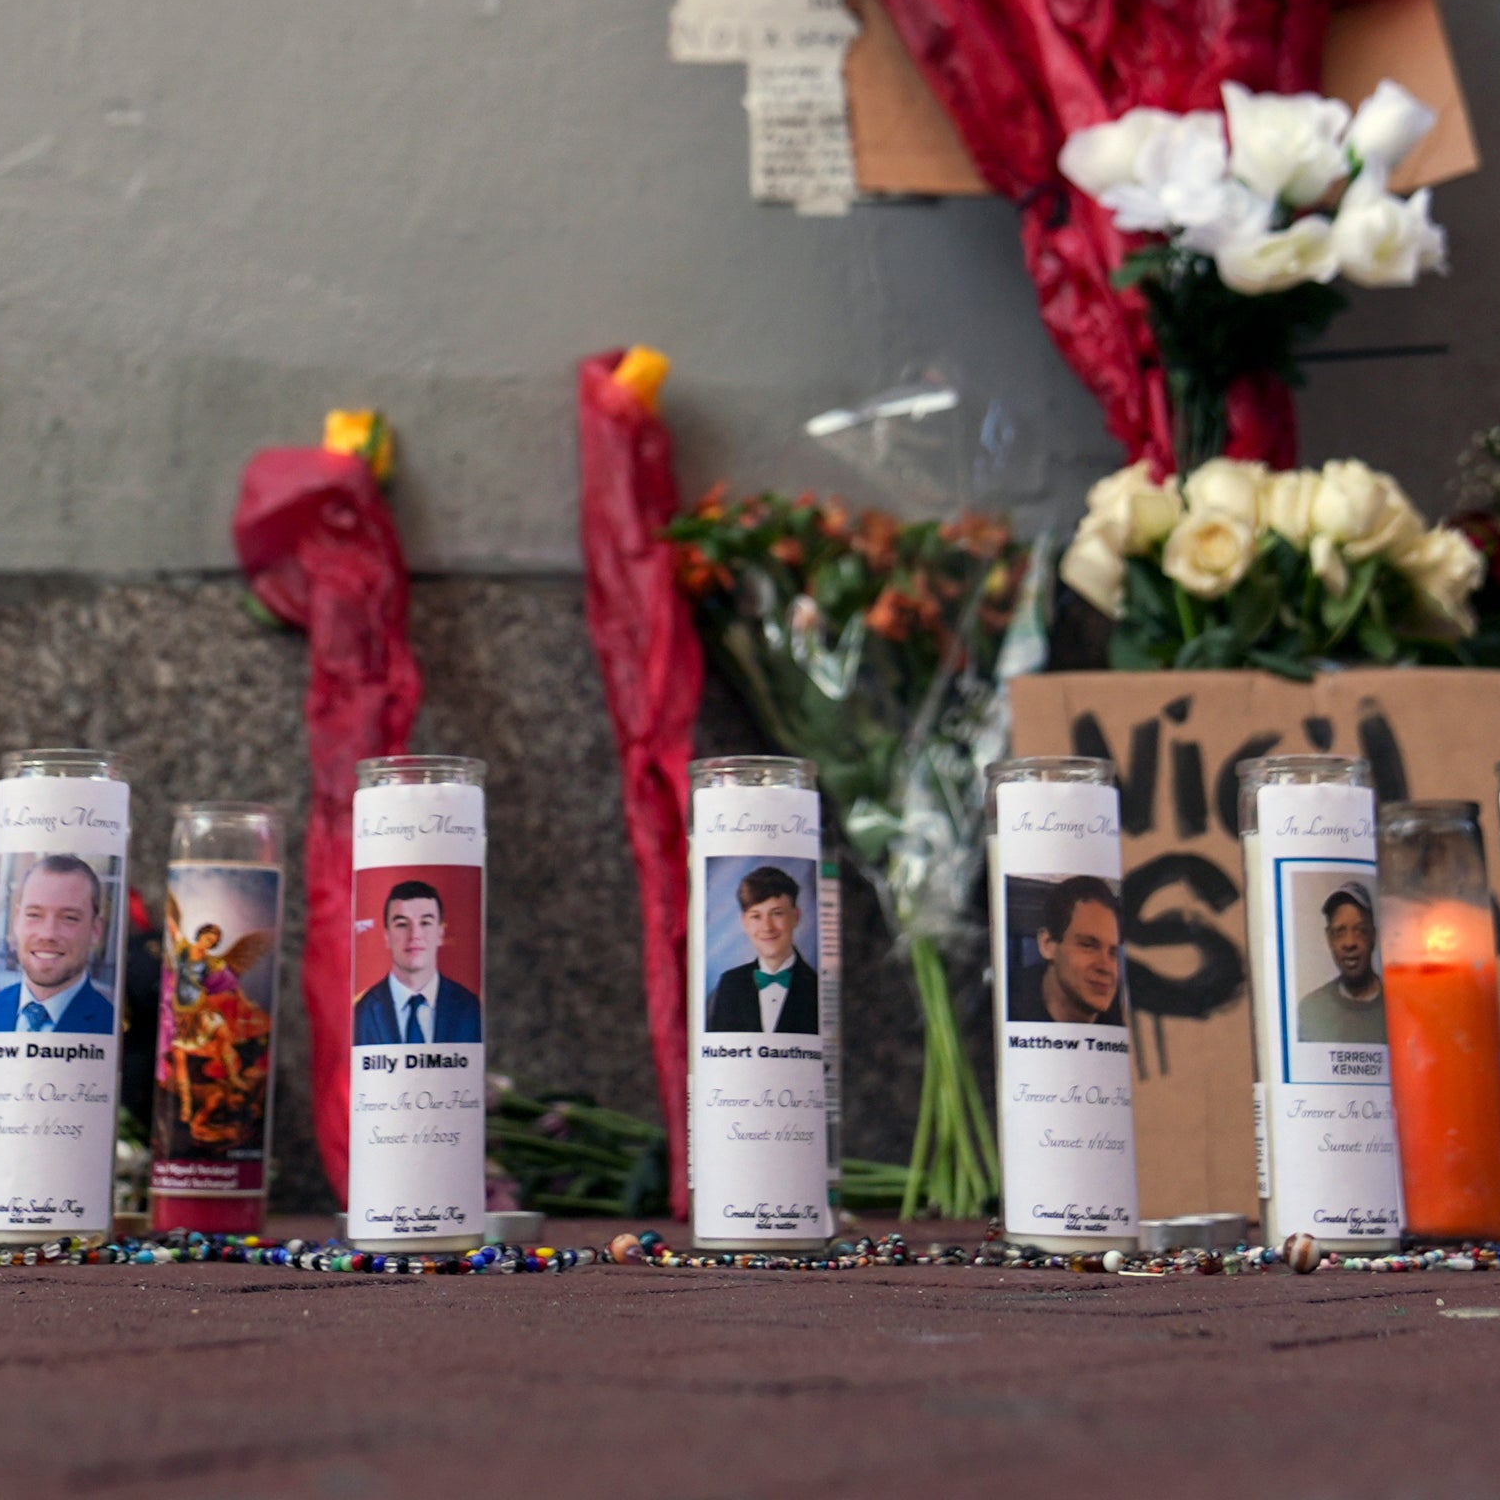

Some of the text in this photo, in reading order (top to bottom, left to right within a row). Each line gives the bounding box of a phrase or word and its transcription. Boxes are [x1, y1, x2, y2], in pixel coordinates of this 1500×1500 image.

[13, 805, 122, 836] Loving Memory
[371, 813, 477, 842] Loving Memory
[707, 812, 779, 839] In Loving
[1012, 811, 1085, 839] In Loving
[1277, 815, 1350, 842] In Loving
[26, 1043, 105, 1063] Dauphin
[701, 1046, 752, 1060] Hubert
[1008, 1036, 1080, 1051] Matthew
[362, 1053, 469, 1073] Billy DiMaio
[1329, 1051, 1383, 1063] TERRENCE
[1332, 1064, 1382, 1076] KENNEDY
[38, 1082, 68, 1102] Our
[415, 1091, 443, 1110] Our
[706, 1088, 801, 1108] Forever In Our
[1013, 1083, 1109, 1105] Forever In Our
[1286, 1099, 1335, 1119] Forever
[1338, 1100, 1359, 1120] In
[727, 1121, 771, 1141] Sunset:
[1039, 1128, 1084, 1148] Sunset:
[1318, 1132, 1363, 1152] Sunset:
[723, 1202, 756, 1219] Created
[1032, 1203, 1065, 1219] Created
[1313, 1208, 1349, 1224] Created
